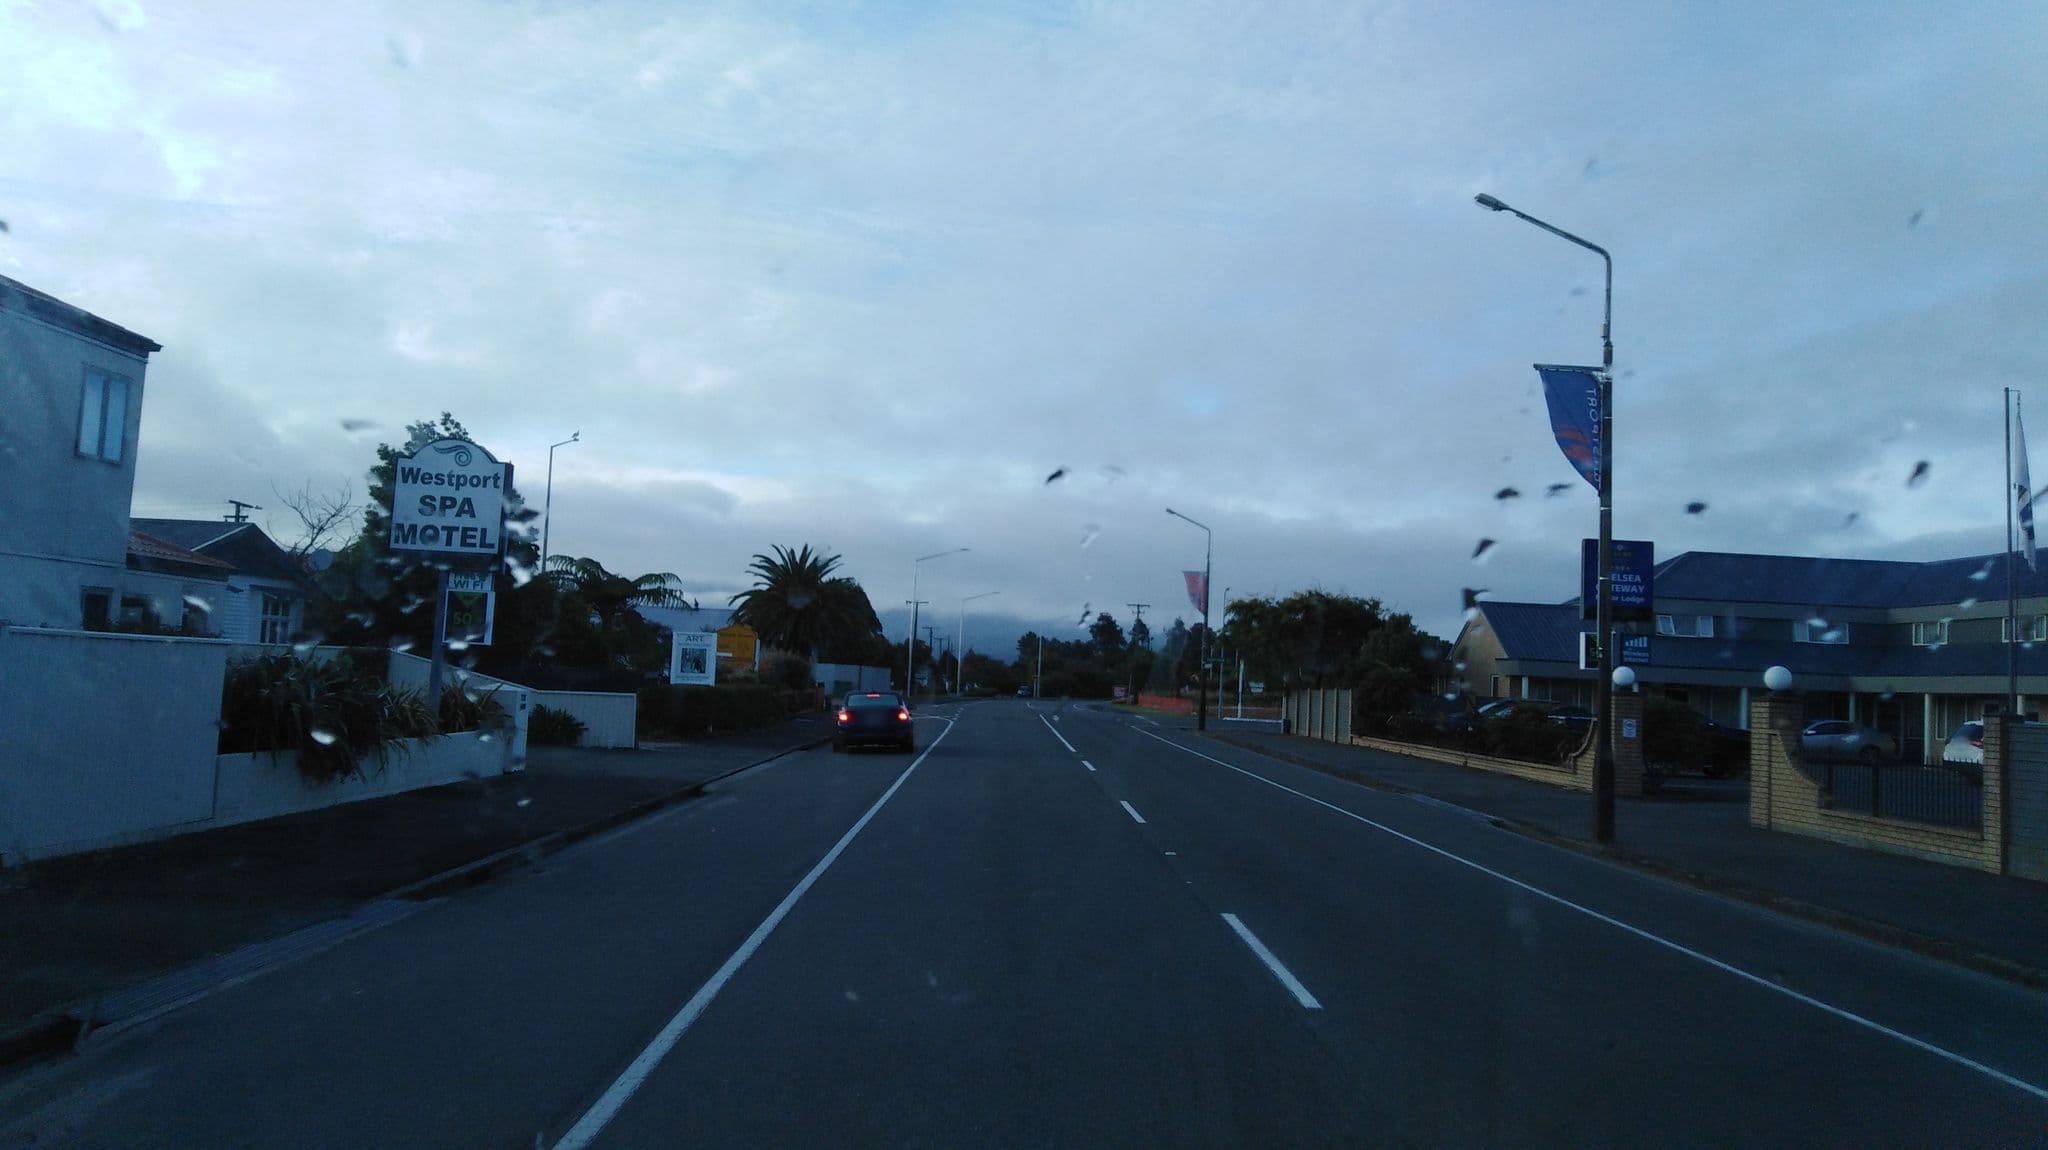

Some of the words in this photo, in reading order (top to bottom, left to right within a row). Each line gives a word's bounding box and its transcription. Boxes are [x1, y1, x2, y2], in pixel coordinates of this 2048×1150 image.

[400, 466, 501, 491] Westport
[418, 494, 476, 518] SPA
[393, 523, 496, 549] MOTEL
[1611, 573, 1642, 583] ELSEA
